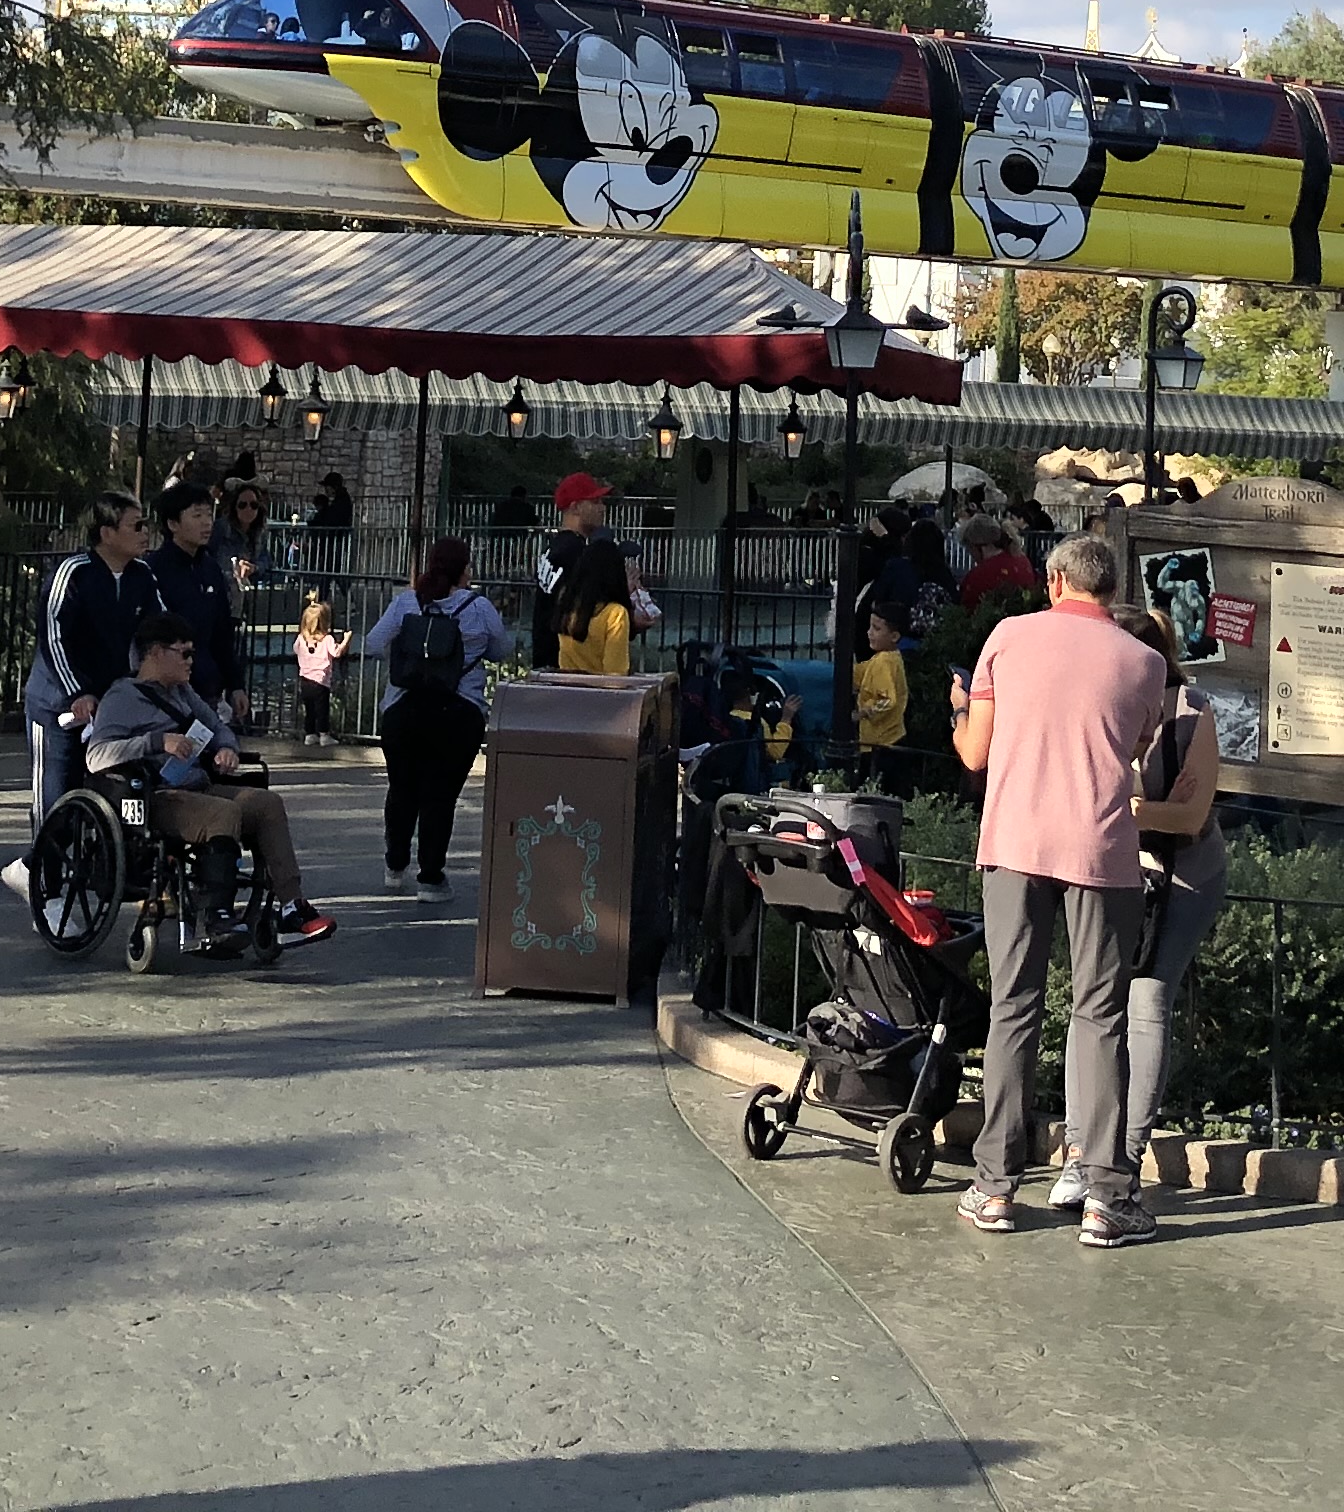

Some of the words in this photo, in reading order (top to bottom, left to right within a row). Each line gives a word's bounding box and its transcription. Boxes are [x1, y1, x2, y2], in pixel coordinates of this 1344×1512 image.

[1232, 484, 1325, 503] Matterhorn
[1261, 504, 1294, 521] Trail
[123, 801, 142, 823] 235
